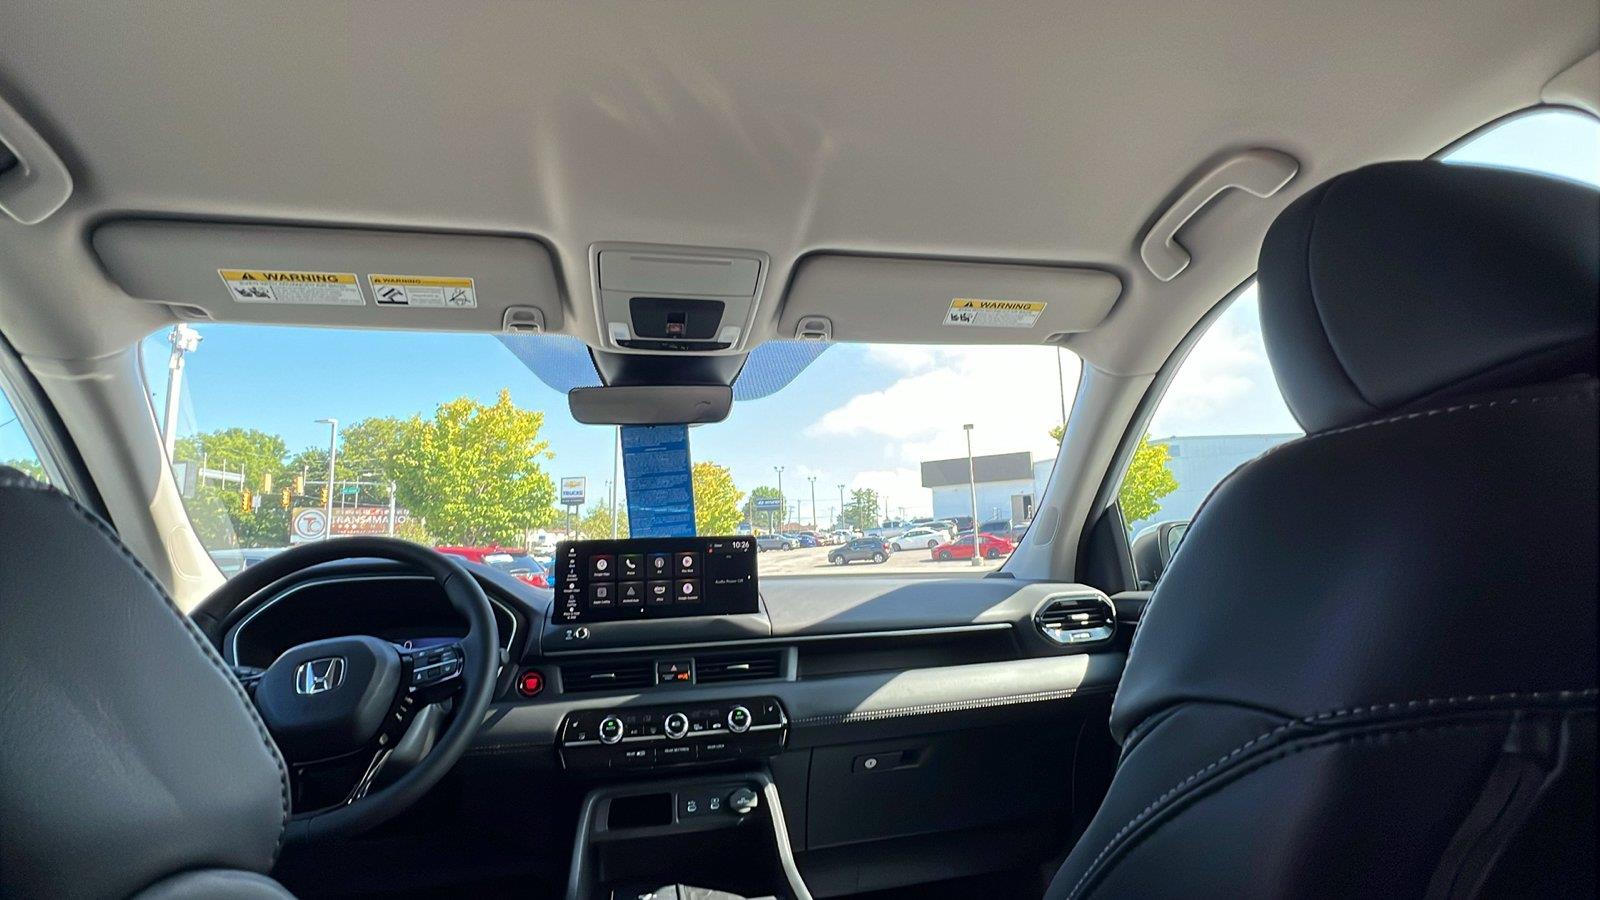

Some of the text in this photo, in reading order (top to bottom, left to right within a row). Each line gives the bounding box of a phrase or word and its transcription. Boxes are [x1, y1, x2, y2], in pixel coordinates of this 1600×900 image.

[262, 272, 339, 283] WARNING
[980, 302, 1031, 310] WARNING
[732, 541, 750, 549] 10:26
